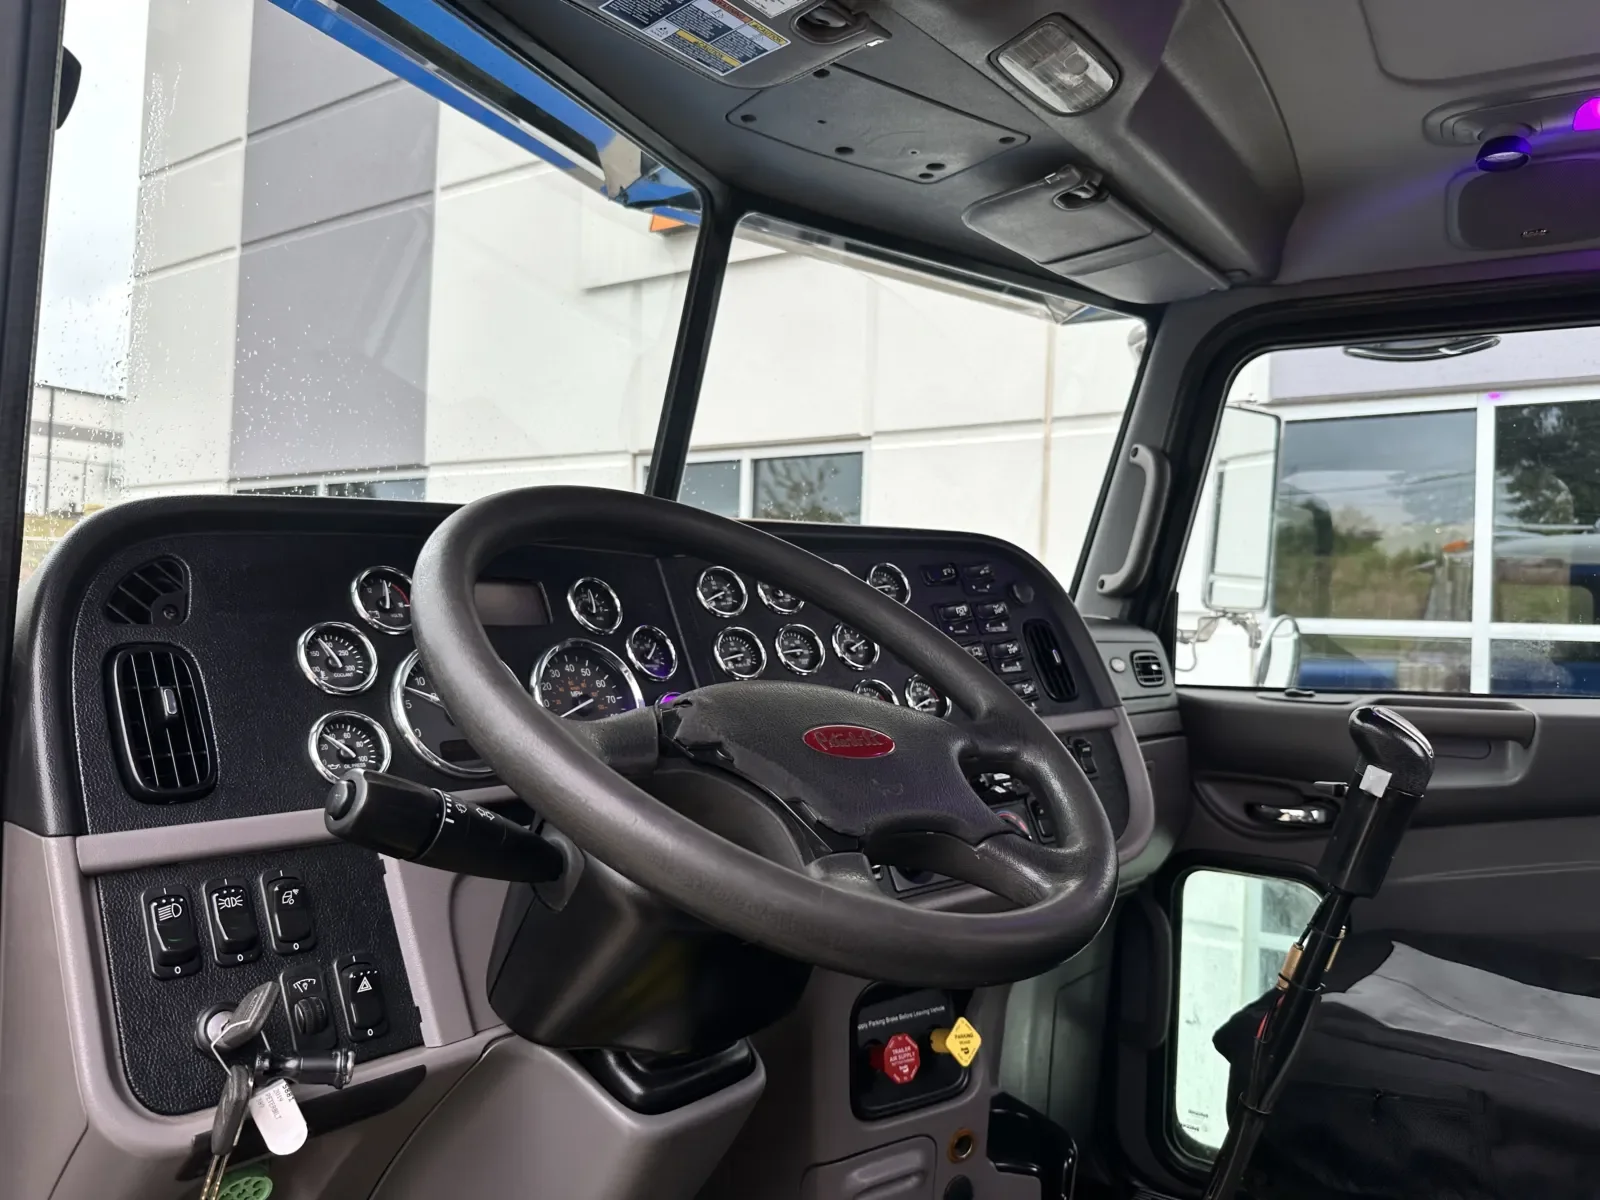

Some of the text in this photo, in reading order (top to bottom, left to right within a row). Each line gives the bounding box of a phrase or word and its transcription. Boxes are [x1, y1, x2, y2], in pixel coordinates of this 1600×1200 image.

[564, 664, 575, 672] 40
[580, 668, 591, 676] 50
[550, 670, 560, 678] 30
[414, 676, 426, 686] 10
[596, 680, 606, 688] 60
[542, 682, 552, 690] 20
[570, 690, 584, 698] MPH
[606, 696, 616, 704] 70
[405, 700, 412, 709] 5
[868, 1018, 886, 1028] Parking
[886, 1014, 898, 1024] Brake
[898, 1012, 913, 1021] Before
[914, 1008, 930, 1018] Leaving
[930, 1005, 945, 1014] Vehicle
[954, 1032, 974, 1040] PARKING
[892, 1046, 911, 1055] TRAILER
[890, 1054, 898, 1062] AIR
[898, 1052, 915, 1060] SUPPLY
[265, 1092, 282, 1120] PETERBILT
